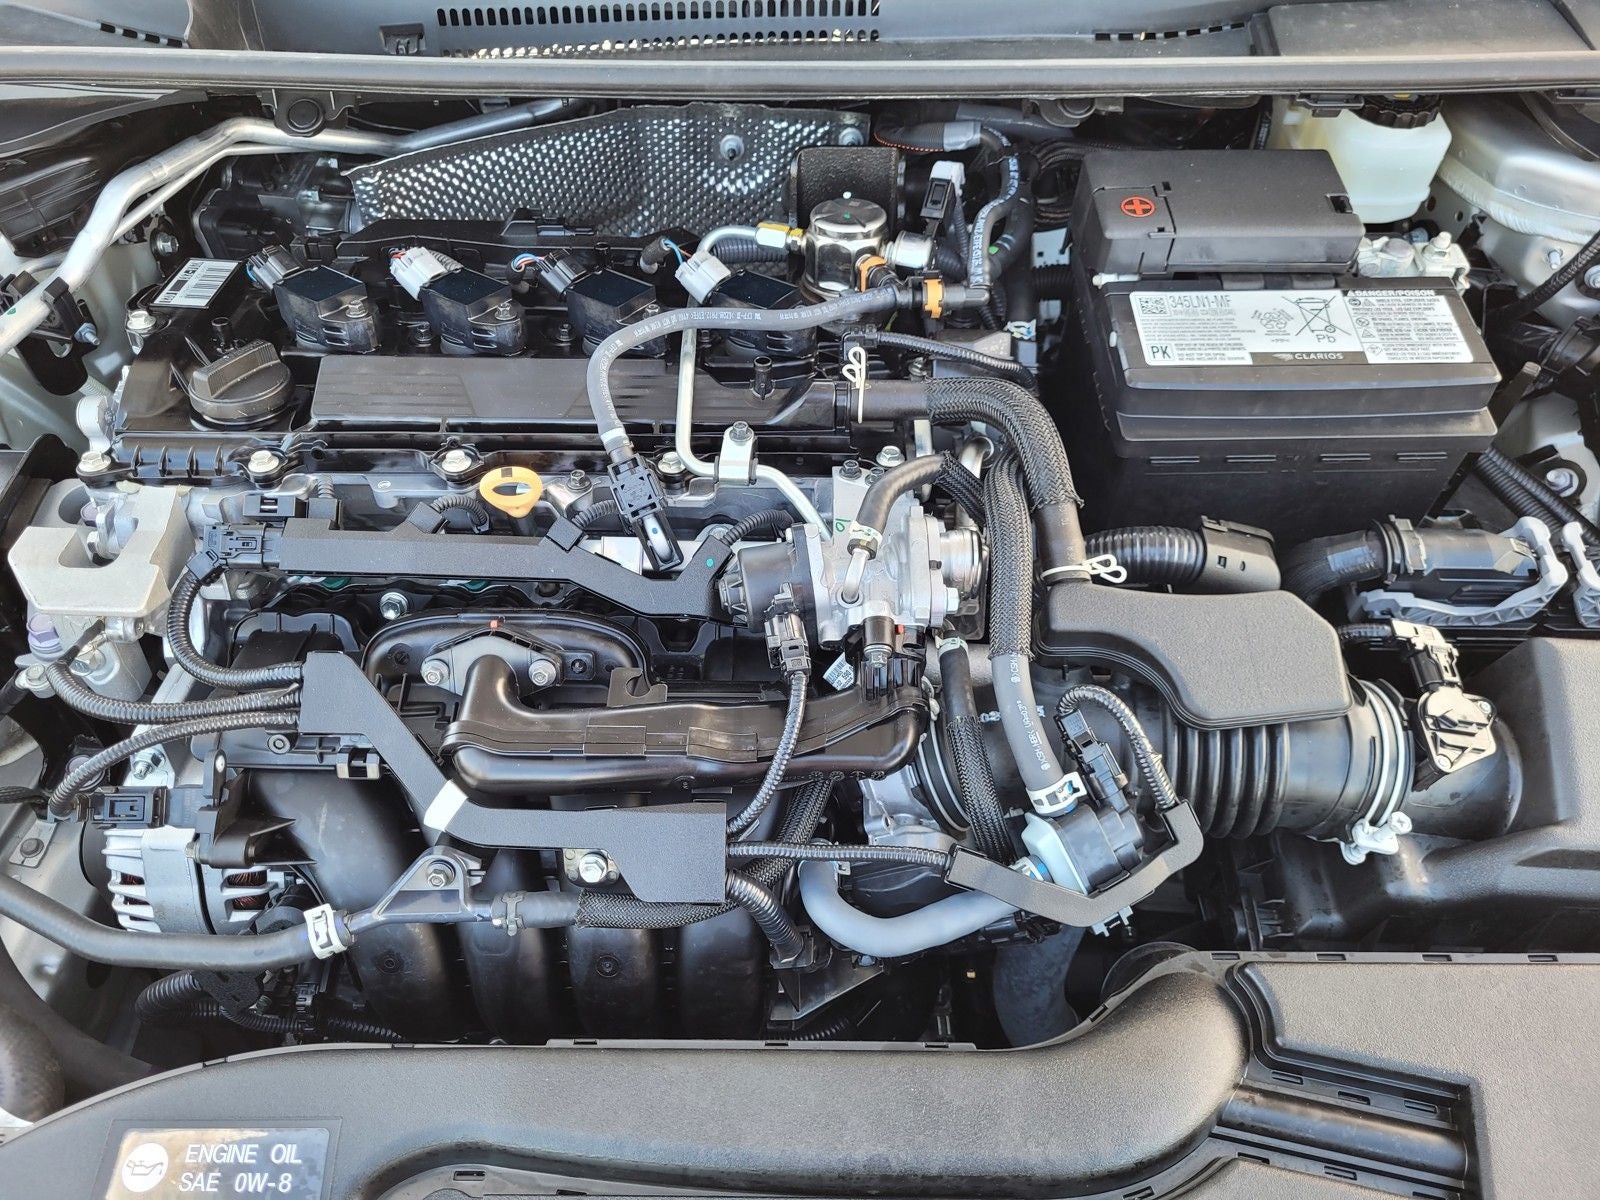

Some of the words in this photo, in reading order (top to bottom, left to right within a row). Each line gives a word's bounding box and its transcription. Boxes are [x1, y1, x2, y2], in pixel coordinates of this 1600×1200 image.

[1169, 294, 1231, 308] 345LN1-MF
[1315, 334, 1337, 344] Pb
[1151, 345, 1171, 360] PK
[185, 1143, 259, 1164] ENGINE
[270, 1143, 302, 1164] OIL
[178, 1172, 220, 1192] SAE
[234, 1172, 293, 1193] 0W-8
